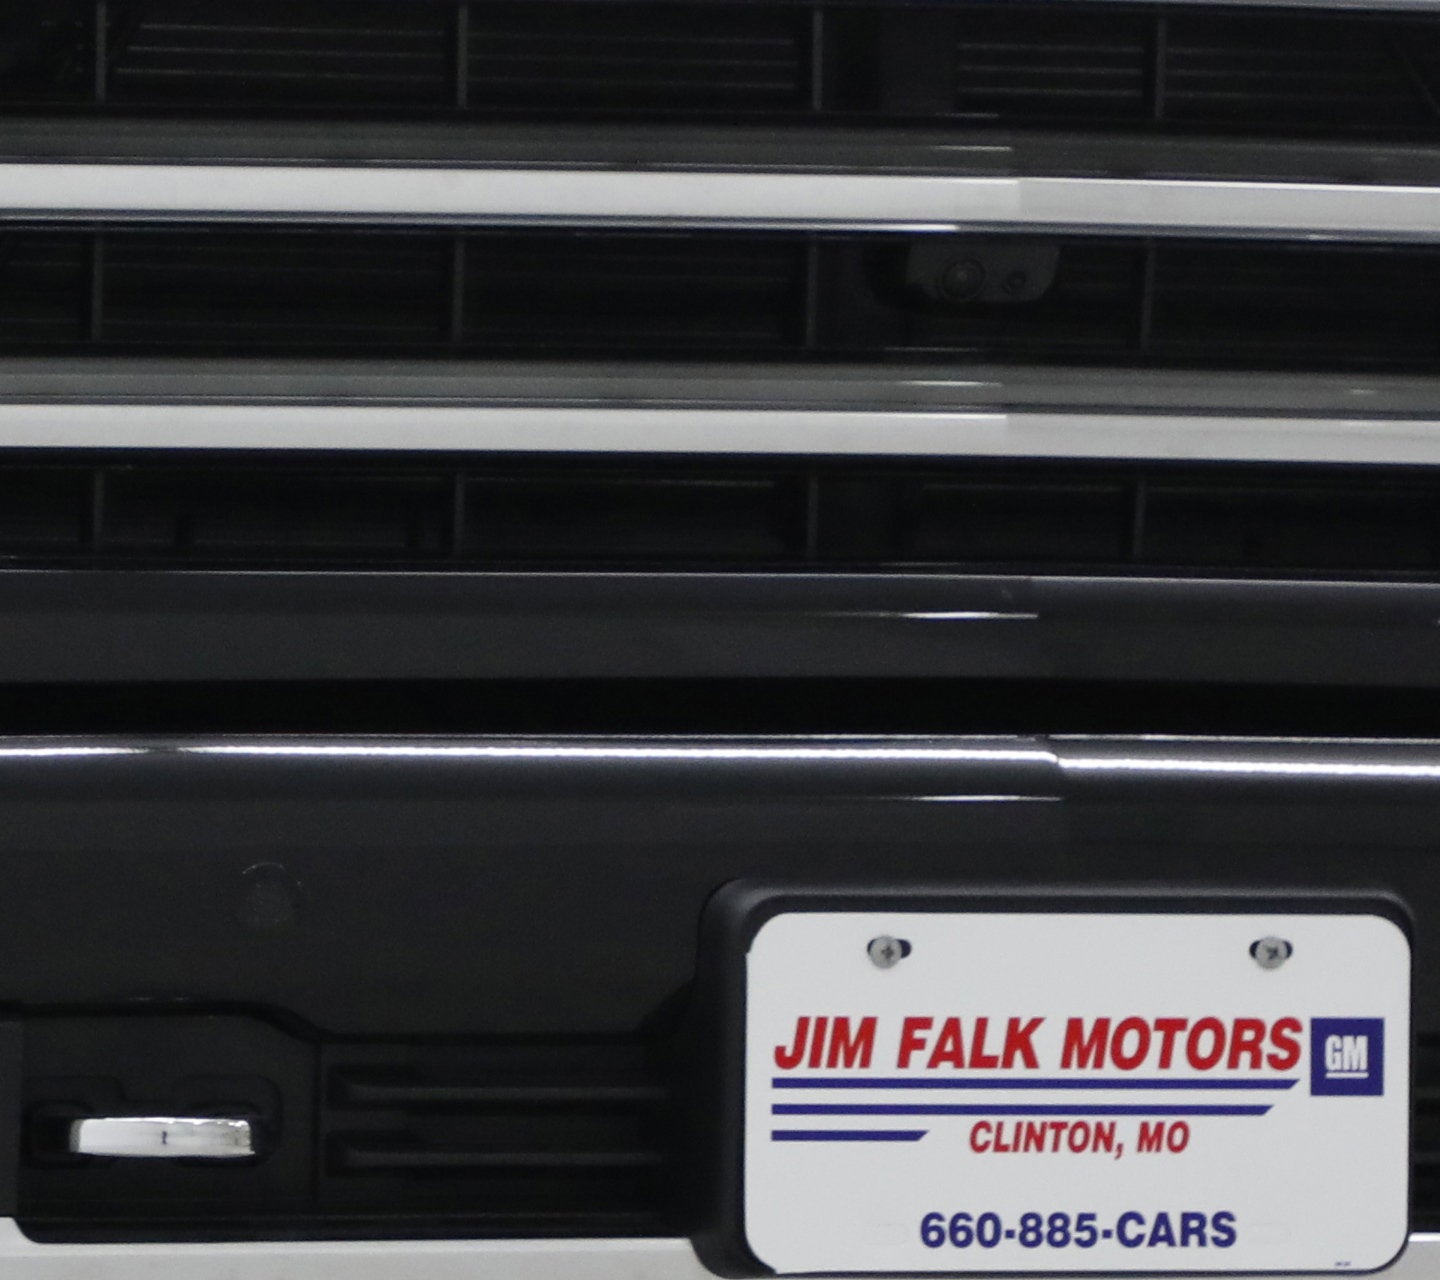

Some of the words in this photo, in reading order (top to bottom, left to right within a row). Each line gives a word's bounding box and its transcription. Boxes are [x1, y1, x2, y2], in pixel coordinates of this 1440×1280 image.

[774, 1016, 877, 1070] JIM
[896, 1017, 1046, 1069] FALK
[1060, 1017, 1303, 1071] MOTORS
[1324, 1034, 1368, 1071] GM
[969, 1120, 1124, 1160] CLINTON,
[1136, 1121, 1190, 1153] MO
[920, 1211, 1237, 1249] 660-885-CARS
